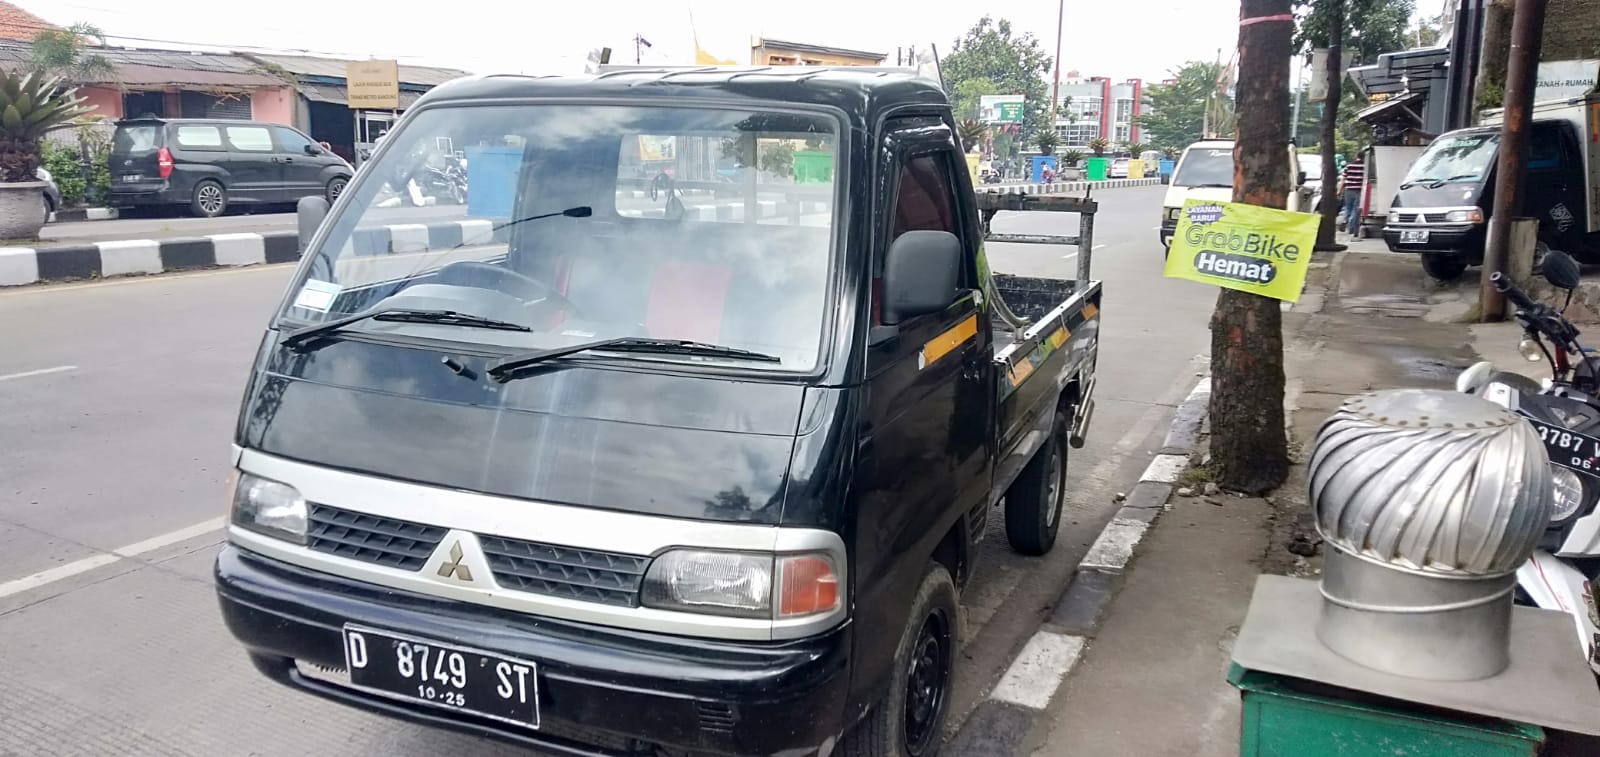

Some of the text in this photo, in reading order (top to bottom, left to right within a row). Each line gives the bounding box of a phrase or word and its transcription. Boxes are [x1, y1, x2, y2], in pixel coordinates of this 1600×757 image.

[1186, 205, 1222, 213] LAYANAN
[1191, 214, 1216, 222] BARU!
[1185, 224, 1300, 262] GrabBike
[1198, 252, 1271, 281] Hemat
[349, 632, 530, 703] D 8749 ST
